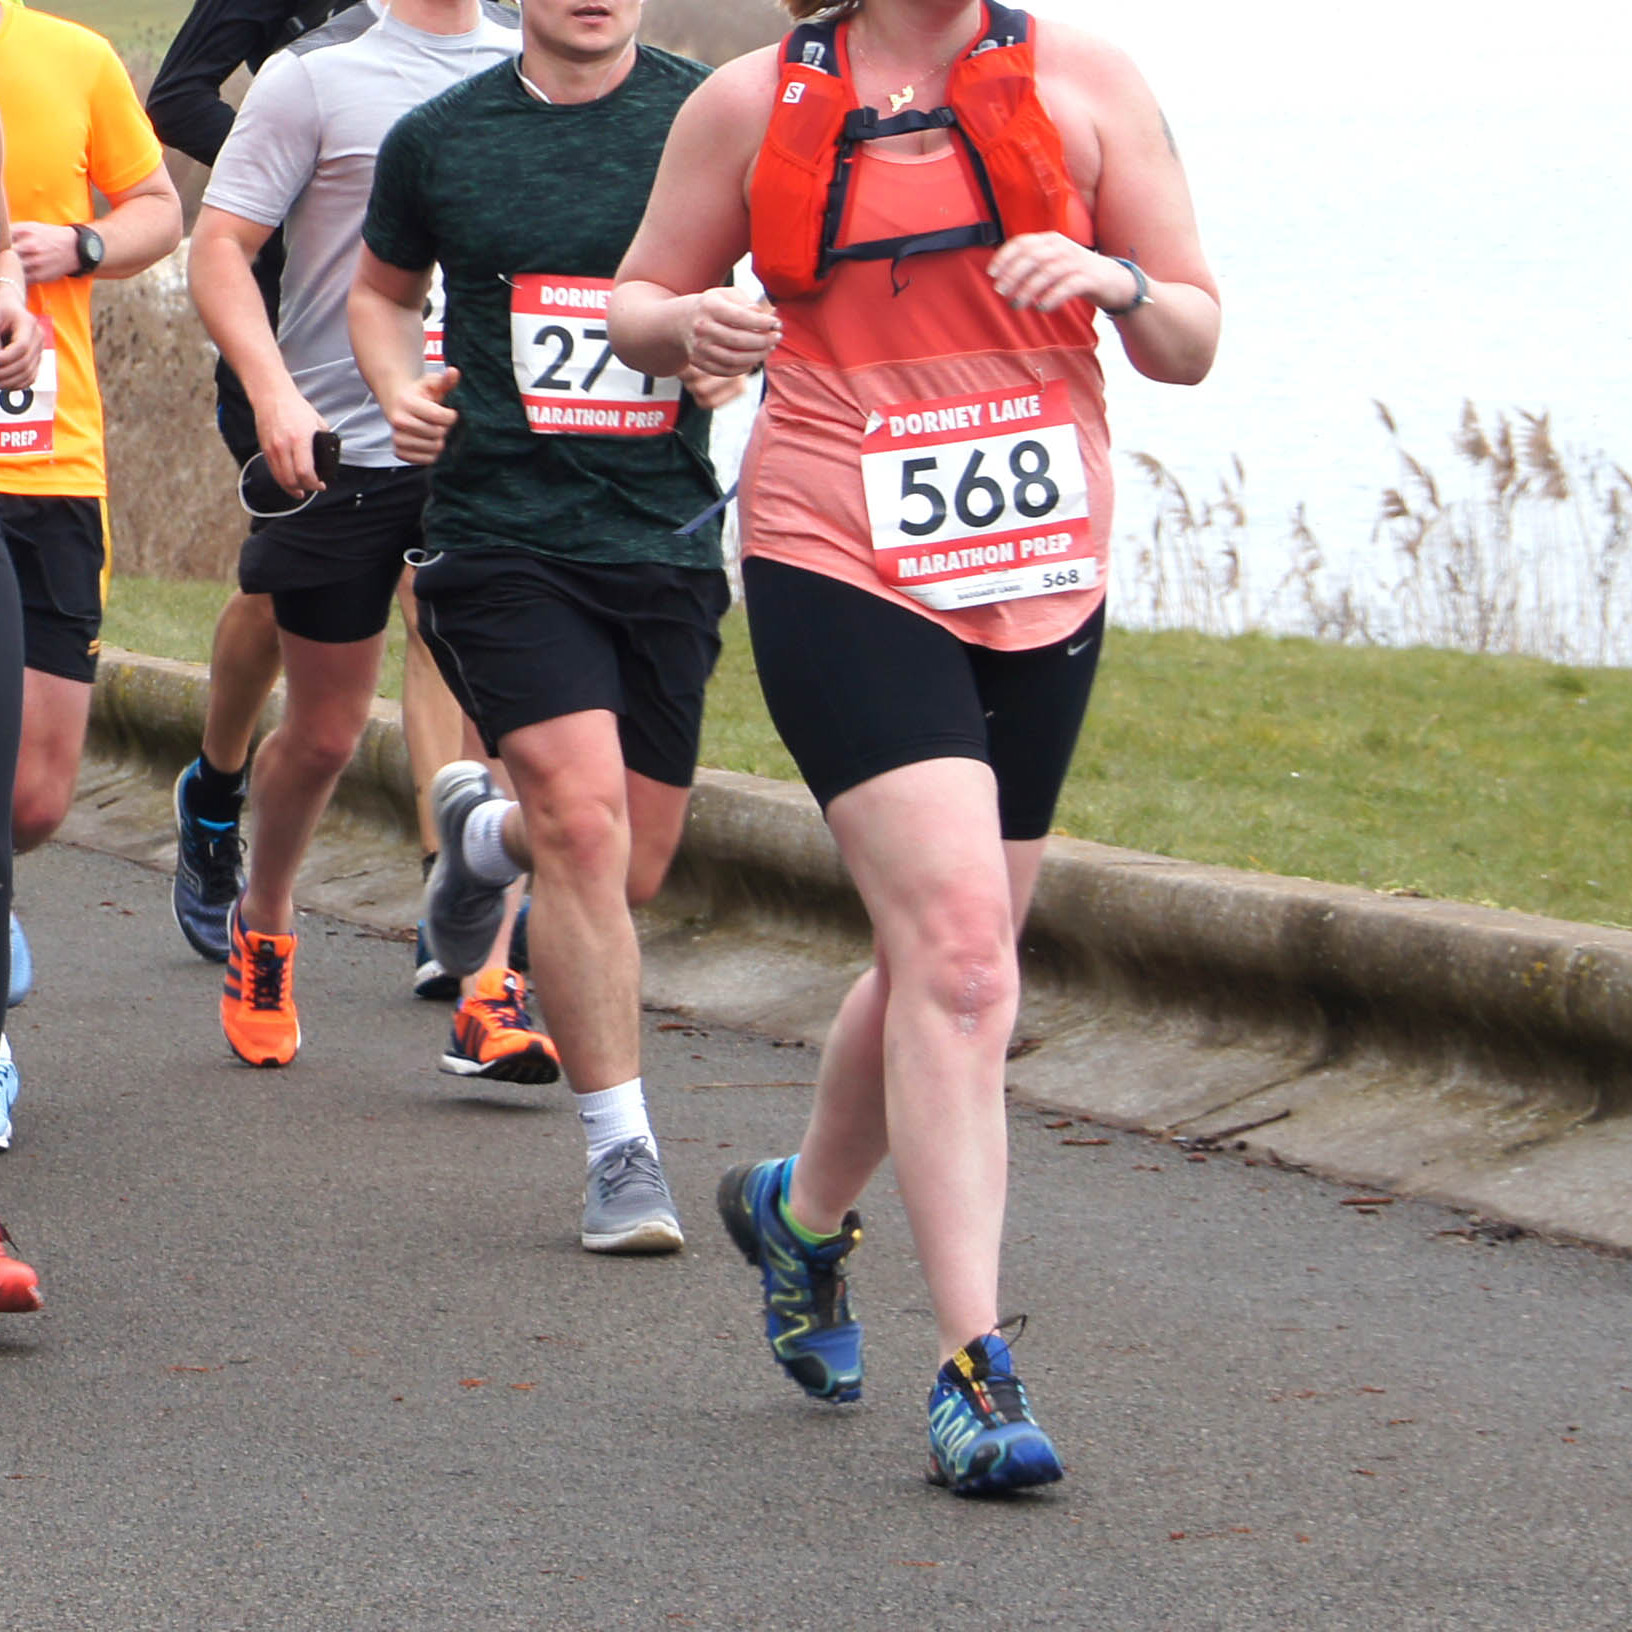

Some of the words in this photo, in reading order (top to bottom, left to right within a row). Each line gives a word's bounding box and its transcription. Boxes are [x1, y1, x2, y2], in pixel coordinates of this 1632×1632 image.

[527, 404, 621, 428] MARATHON
[624, 410, 666, 428] PREP
[889, 404, 983, 437] DORNEY
[987, 394, 1042, 424] LAKE
[0, 429, 38, 448] PREP
[898, 439, 1060, 537] 568
[897, 541, 1015, 579] MARATHON
[1019, 532, 1073, 559] PREP
[1041, 568, 1080, 588] 568
